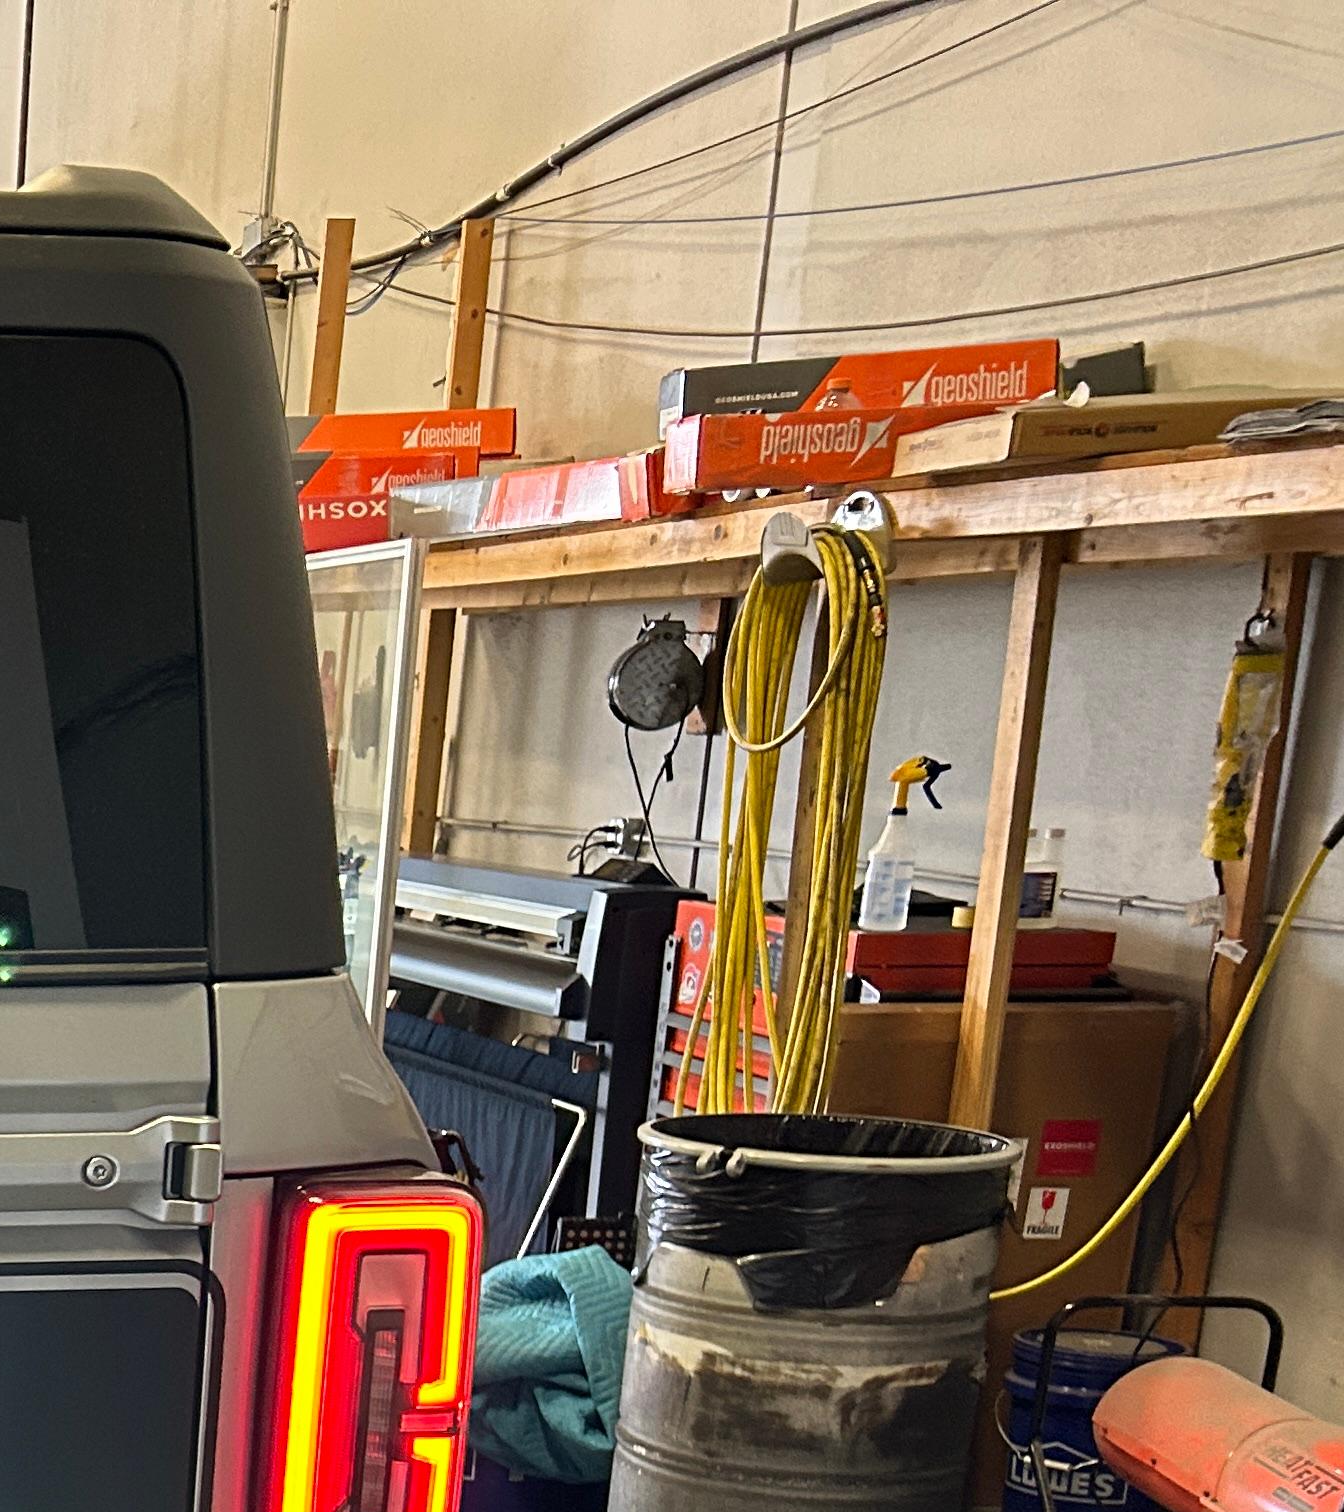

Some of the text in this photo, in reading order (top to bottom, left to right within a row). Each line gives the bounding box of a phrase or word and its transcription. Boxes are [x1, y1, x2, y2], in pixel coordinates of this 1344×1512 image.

[931, 361, 1027, 406] geoshield
[420, 420, 482, 448] geoshield
[760, 417, 862, 465] geoshield
[1291, 1469, 1341, 1500] FAST
